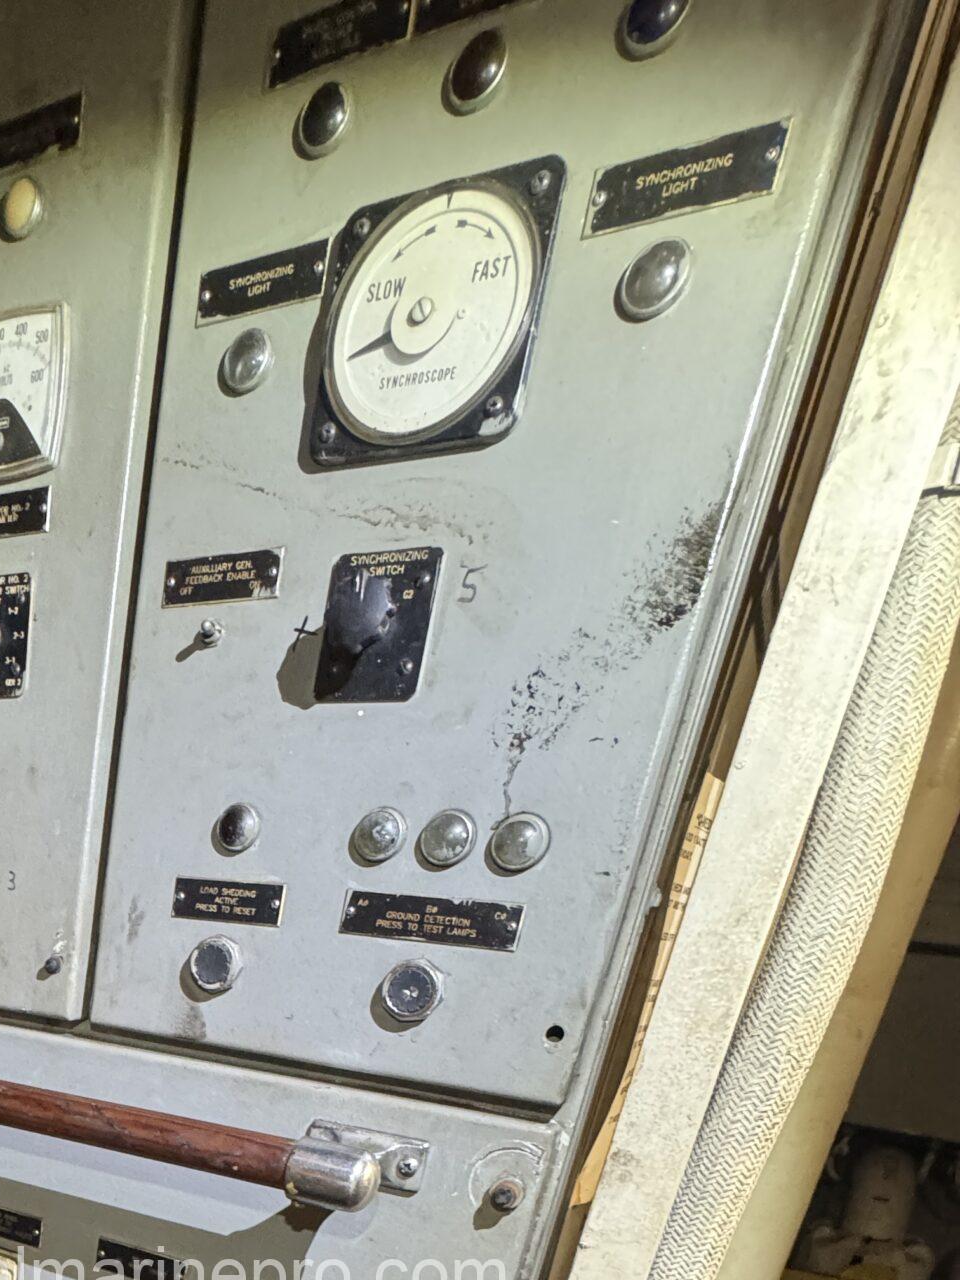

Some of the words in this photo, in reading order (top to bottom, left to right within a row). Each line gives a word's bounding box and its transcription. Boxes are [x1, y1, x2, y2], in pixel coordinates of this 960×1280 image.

[635, 152, 734, 190] SYNCHRONIZING
[661, 177, 698, 198] LIGHT
[228, 263, 295, 290] SYNCHRONIZING
[471, 255, 512, 283] FAST
[247, 282, 271, 297] LIGHT
[366, 276, 407, 303] SLOW
[35, 329, 49, 344] 500
[379, 366, 457, 390] SYNCHROSCOPE
[350, 549, 429, 566] SYNCHRONIZING
[226, 570, 257, 581] ENABLE
[369, 564, 405, 577] SWITCH
[179, 586, 194, 596] OFF
[457, 561, 488, 603] 5
[221, 905, 230, 913] TO
[385, 910, 421, 922] GROUND
[423, 915, 471, 928] DETECTION
[375, 919, 402, 930] PRESS
[407, 922, 419, 931] TO
[423, 924, 443, 934] TEST
[447, 927, 477, 938] LAMPS
